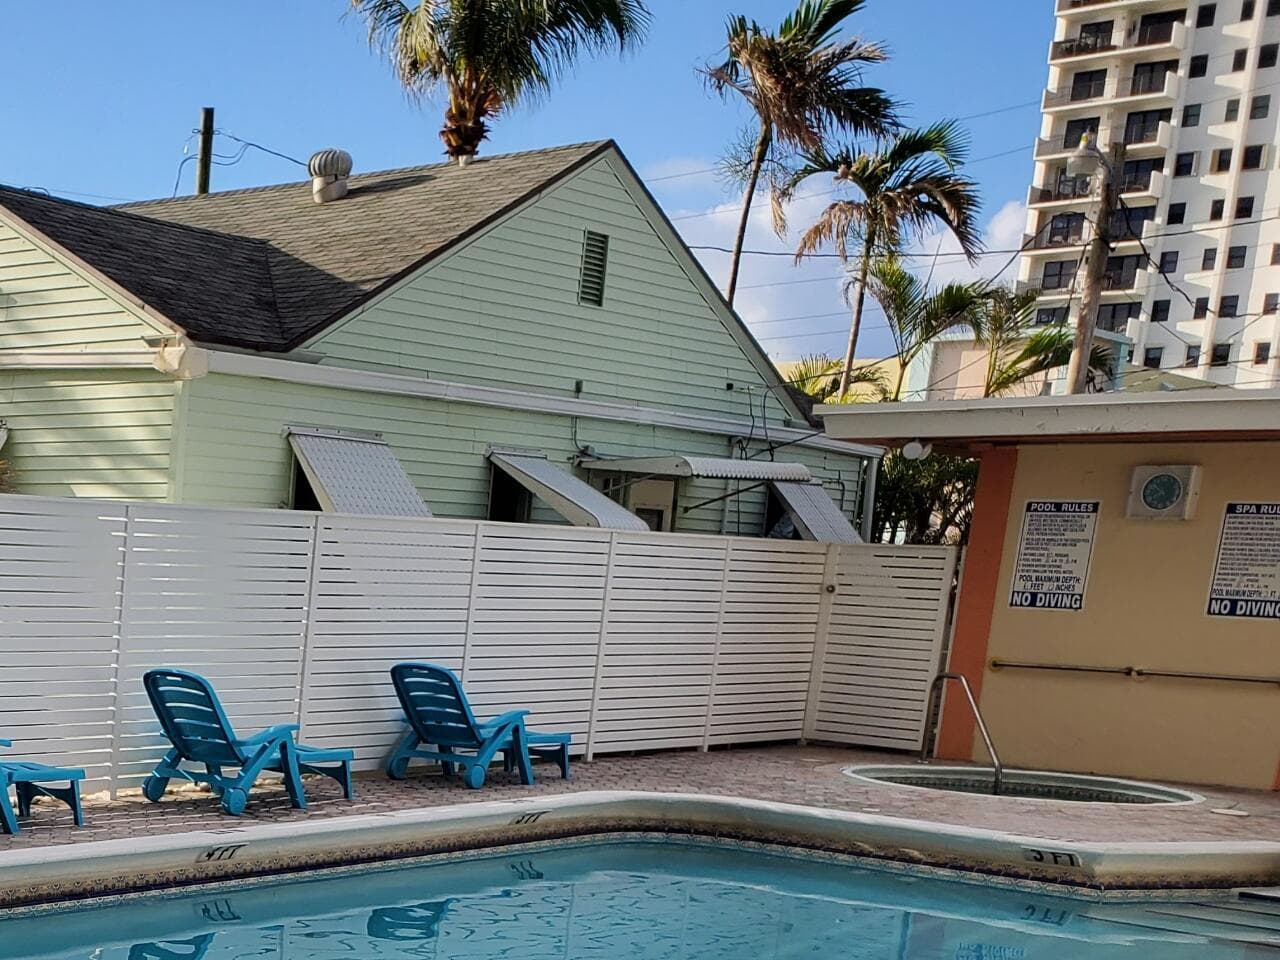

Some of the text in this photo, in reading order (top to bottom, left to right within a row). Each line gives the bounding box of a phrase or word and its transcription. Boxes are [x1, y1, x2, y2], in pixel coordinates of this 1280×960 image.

[1031, 503, 1094, 512] POOL RULES
[1235, 504, 1257, 513] SPA
[1019, 574, 1033, 582] POOL
[1035, 575, 1061, 583] MAXIMUM
[1012, 592, 1081, 608] NO DIVING
[1210, 599, 1231, 614] NO
[1050, 852, 1075, 866] FT
